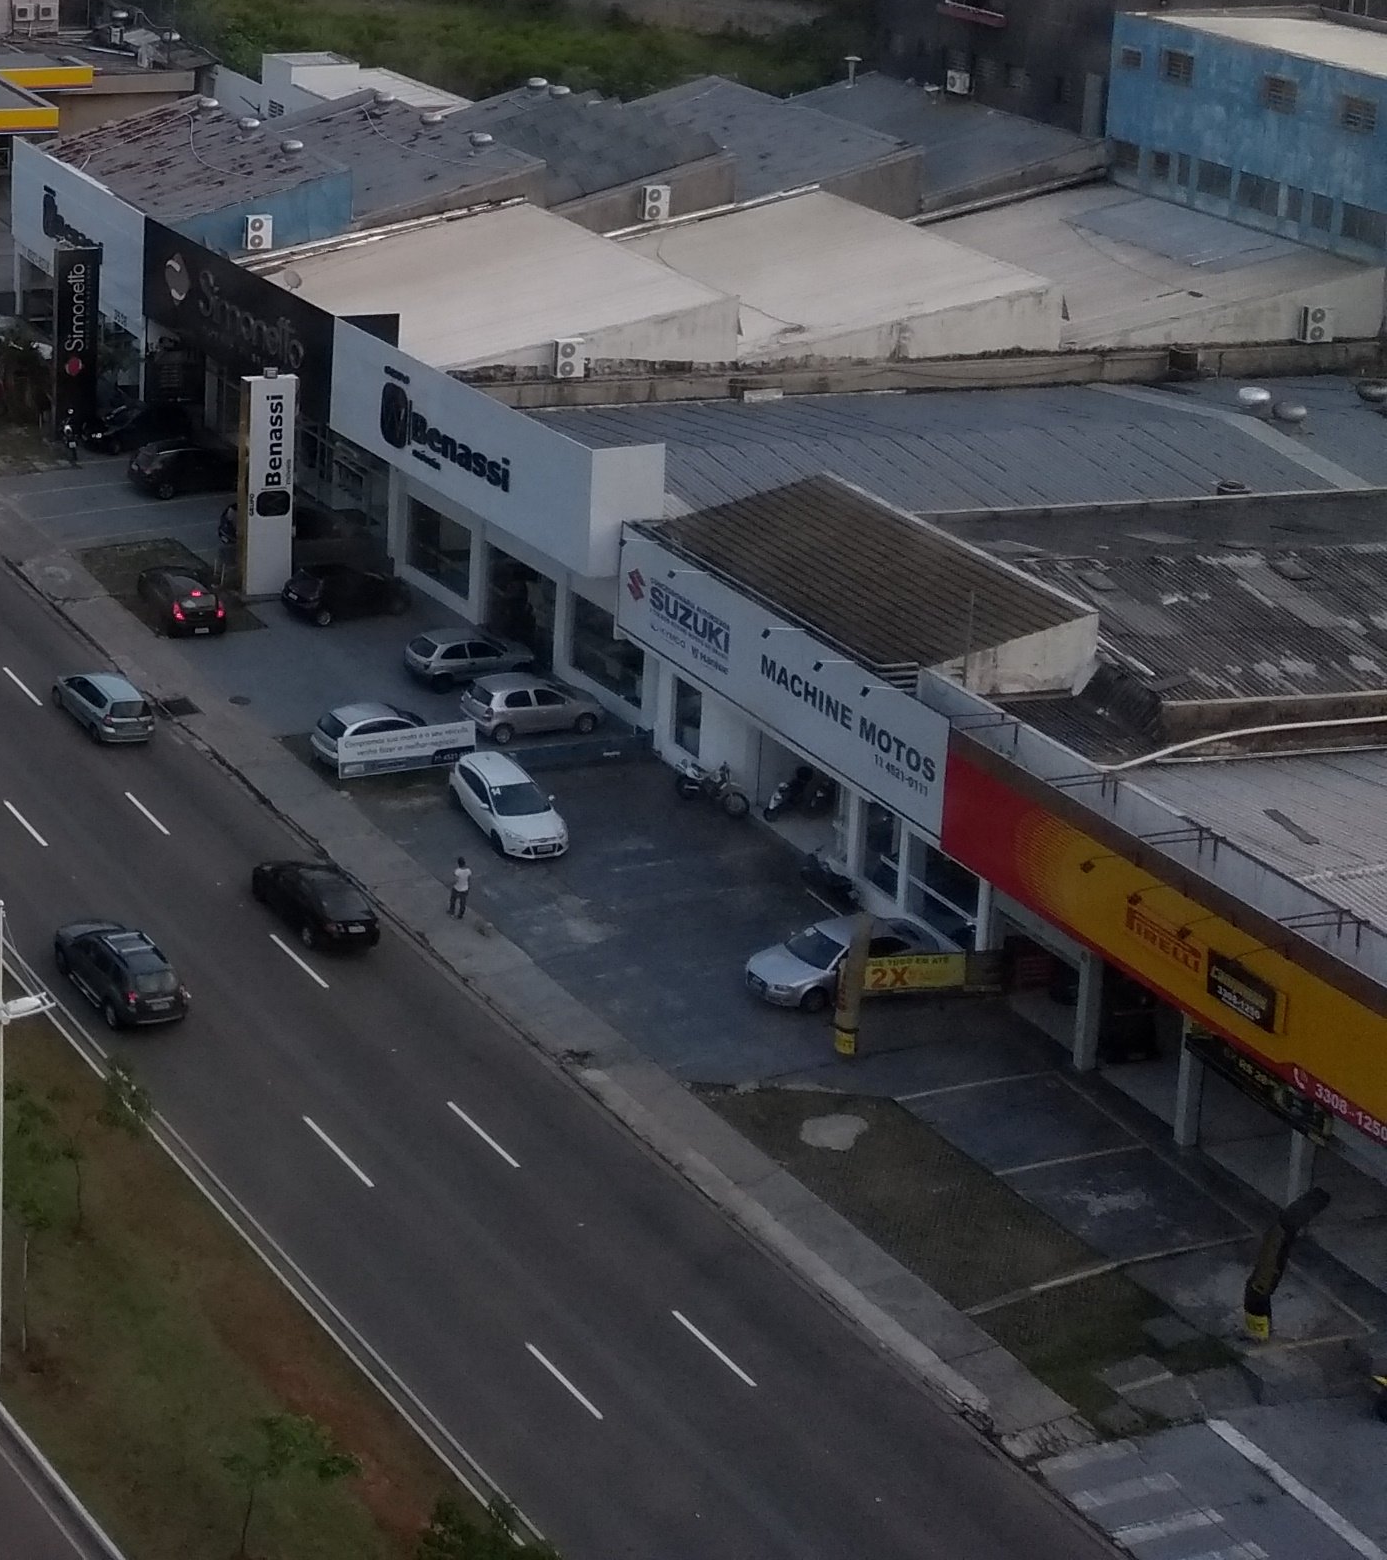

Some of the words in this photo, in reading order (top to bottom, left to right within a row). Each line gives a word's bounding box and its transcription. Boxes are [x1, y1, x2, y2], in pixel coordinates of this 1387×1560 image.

[64, 263, 86, 353] Simonetto
[199, 270, 304, 369] Simonetto
[265, 394, 284, 487] Benassi
[411, 411, 510, 493] Benassi
[649, 586, 730, 654] SUZUKI
[761, 654, 853, 731] MACHINE
[859, 715, 936, 783] MOTOS
[1126, 904, 1202, 973] PIRELLI
